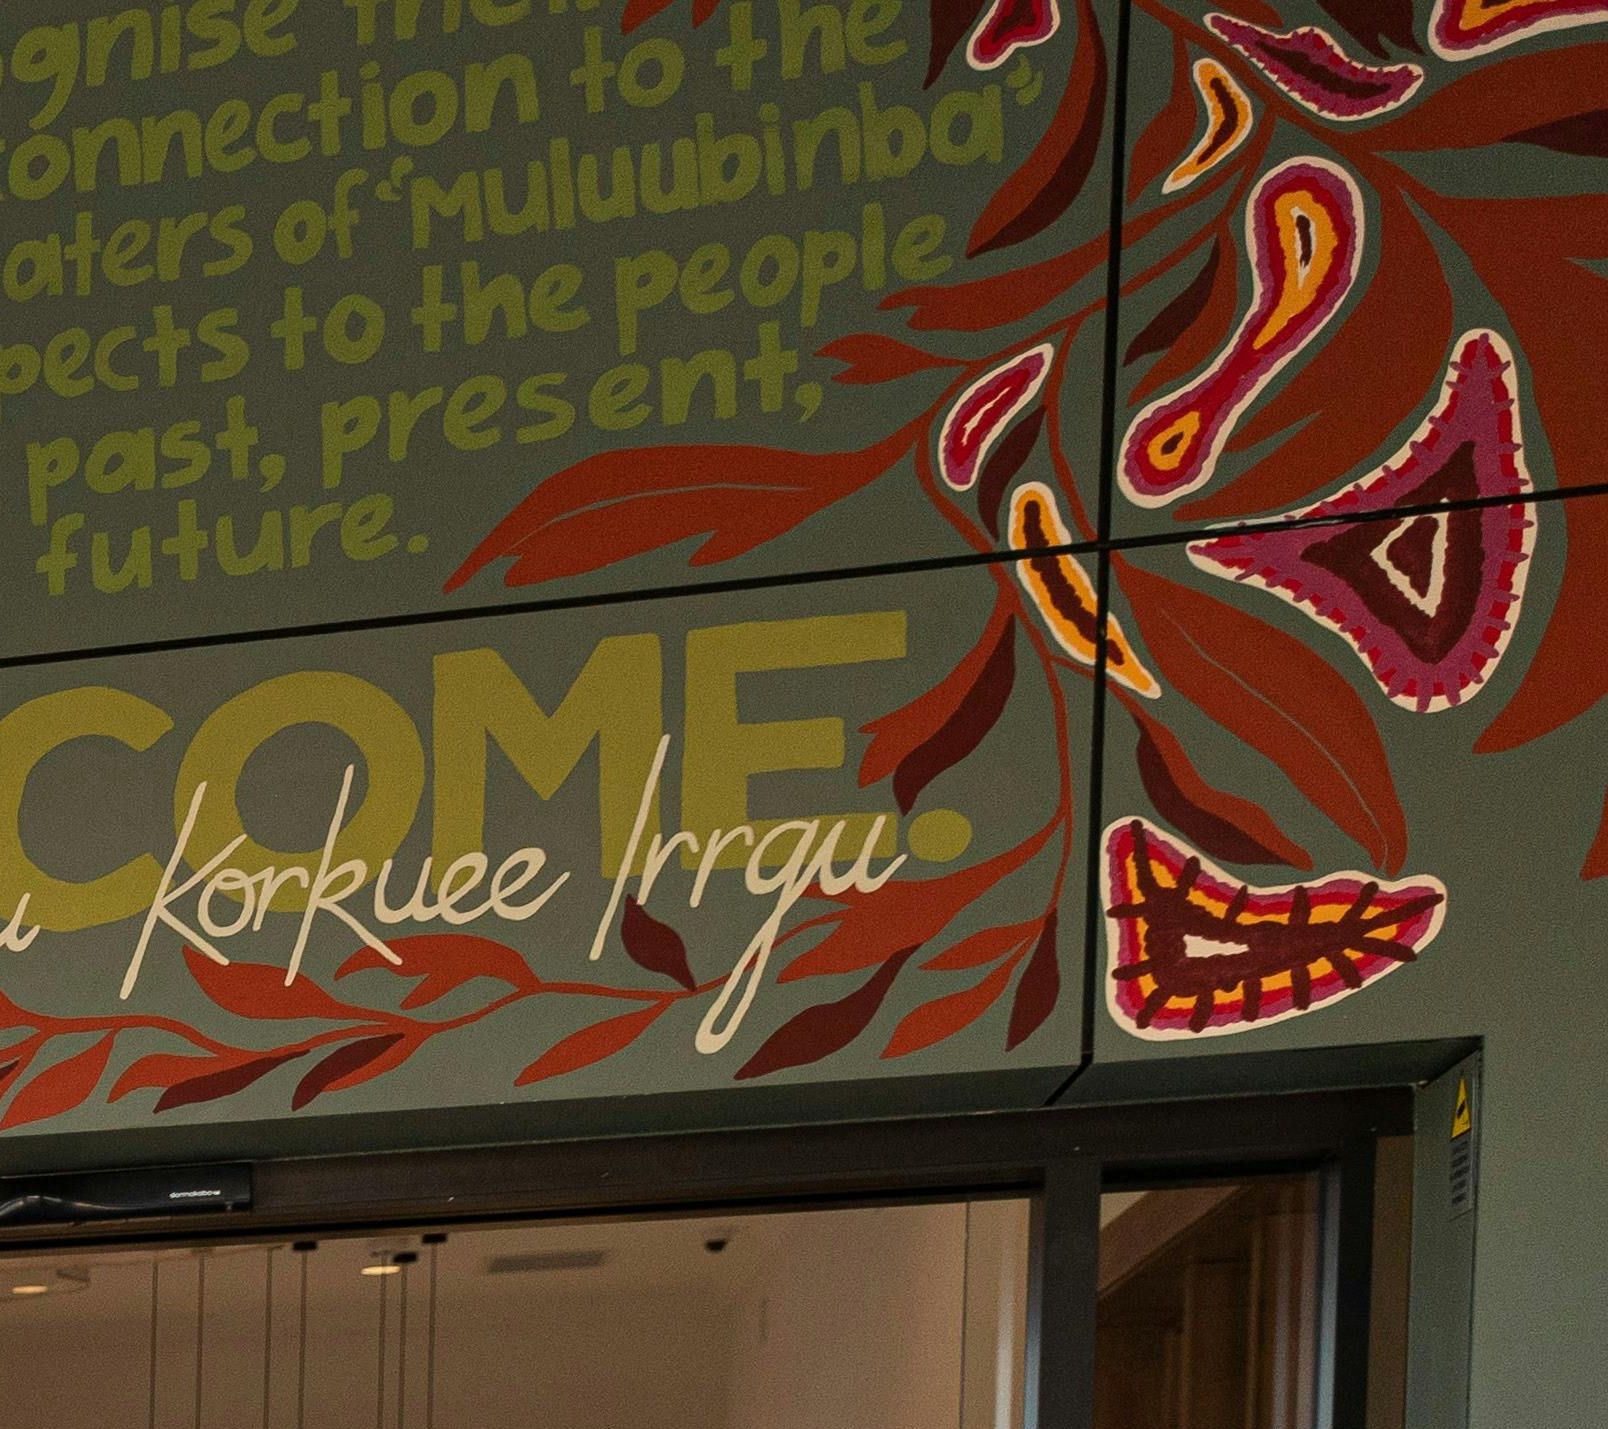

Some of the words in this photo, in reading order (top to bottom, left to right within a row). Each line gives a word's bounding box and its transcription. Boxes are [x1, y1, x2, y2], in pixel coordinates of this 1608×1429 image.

[570, 27, 684, 113] to
[716, 0, 907, 90] the
[274, 168, 367, 265] of
[272, 287, 385, 371] to
[413, 262, 589, 352] the
[616, 203, 950, 355] people
[26, 396, 286, 525] past,
[322, 322, 824, 488] present,
[36, 493, 428, 597] future.
[120, 764, 570, 1000] Korkuee
[589, 734, 907, 1055] Irrgu
